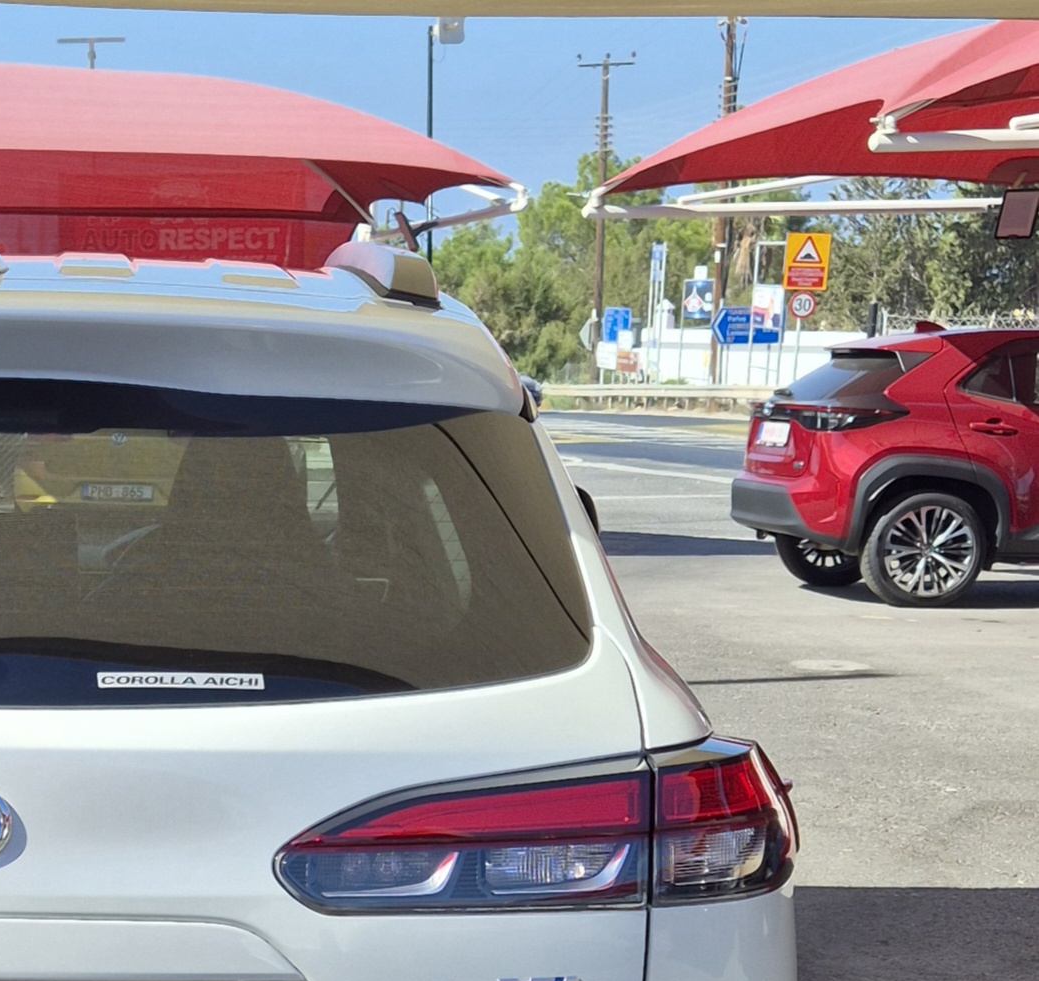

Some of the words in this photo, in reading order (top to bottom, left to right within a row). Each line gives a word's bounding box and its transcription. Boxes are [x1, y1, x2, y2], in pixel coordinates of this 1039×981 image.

[82, 226, 281, 251] AUTORESPECT
[794, 298, 812, 312] 30
[100, 675, 196, 686] COROLLA
[203, 676, 259, 687] AICHI
